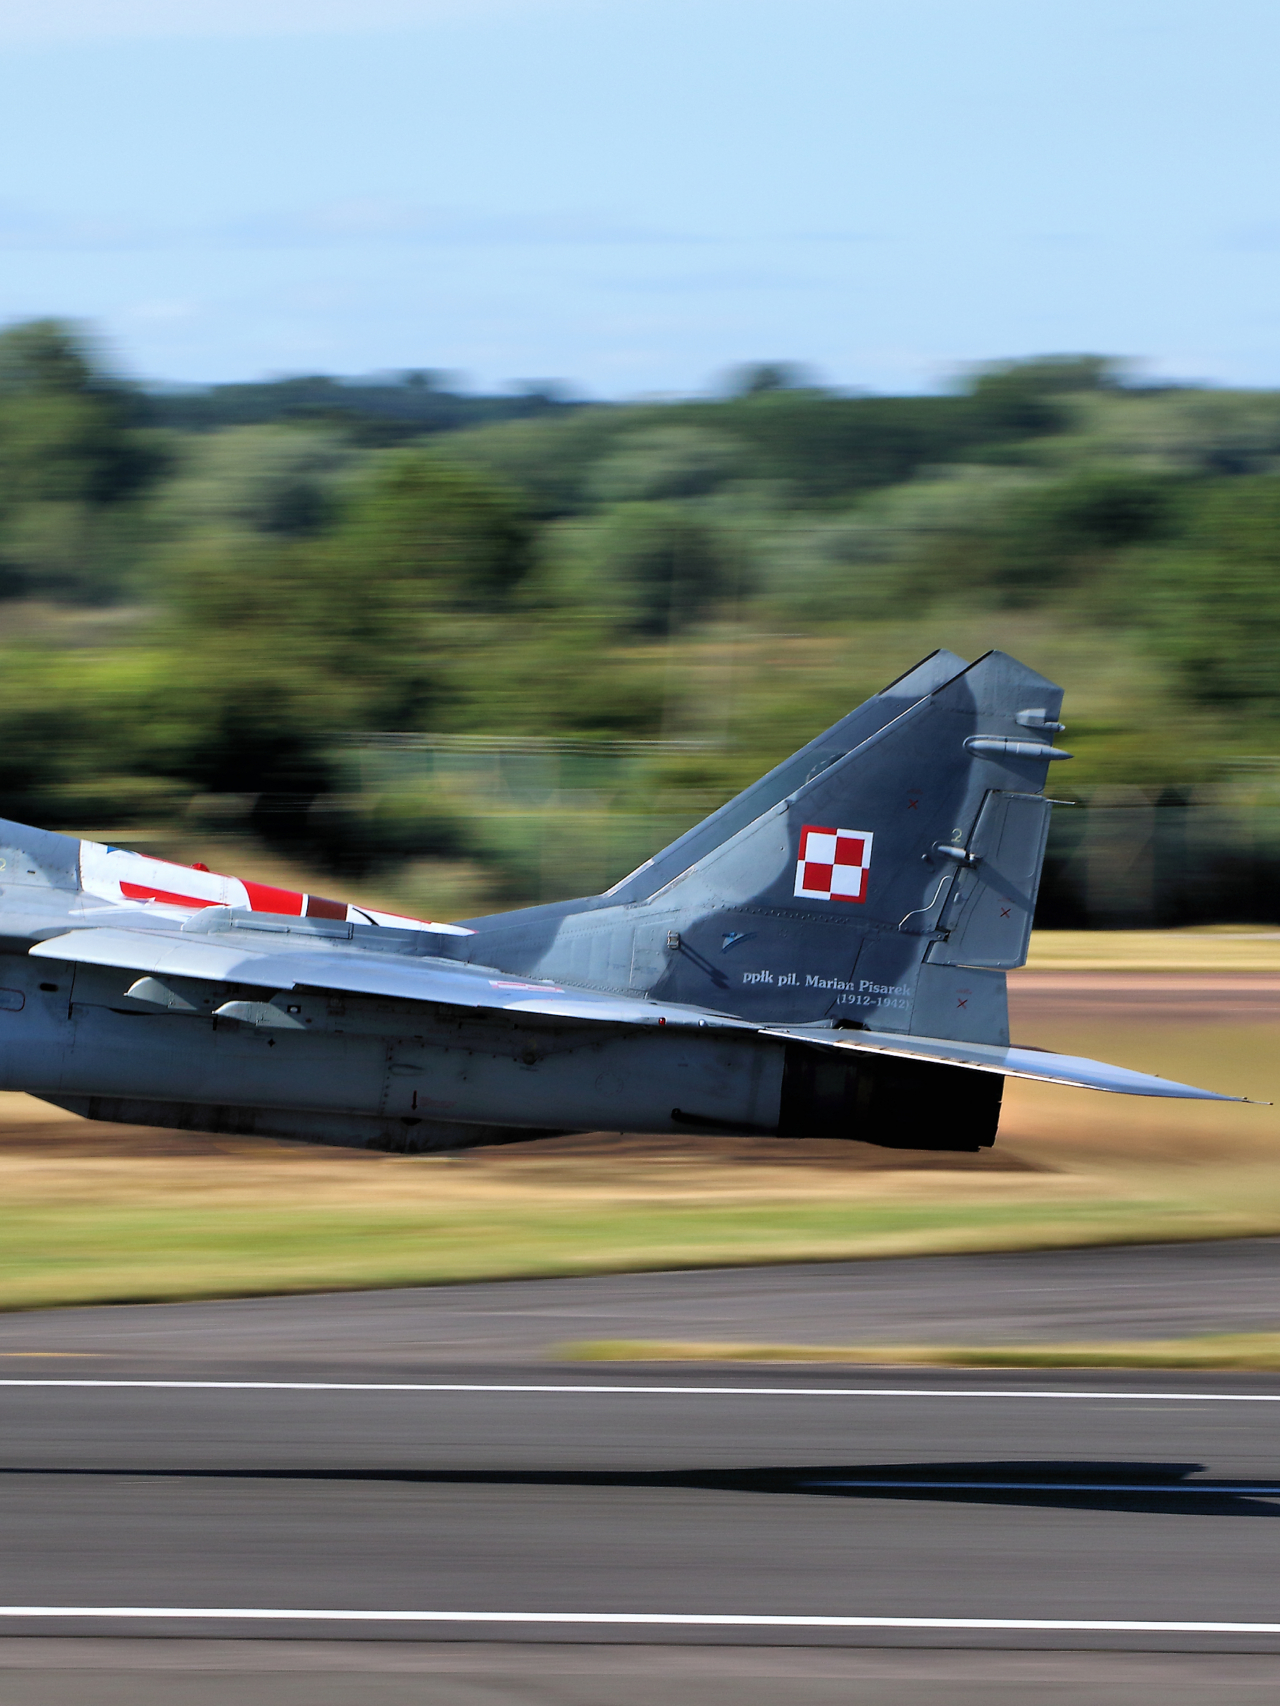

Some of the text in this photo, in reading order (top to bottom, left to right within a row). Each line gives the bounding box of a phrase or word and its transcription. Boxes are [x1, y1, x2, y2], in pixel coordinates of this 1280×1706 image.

[951, 828, 963, 842] 2
[743, 970, 911, 996] ppłk pil. Marian Pisarek
